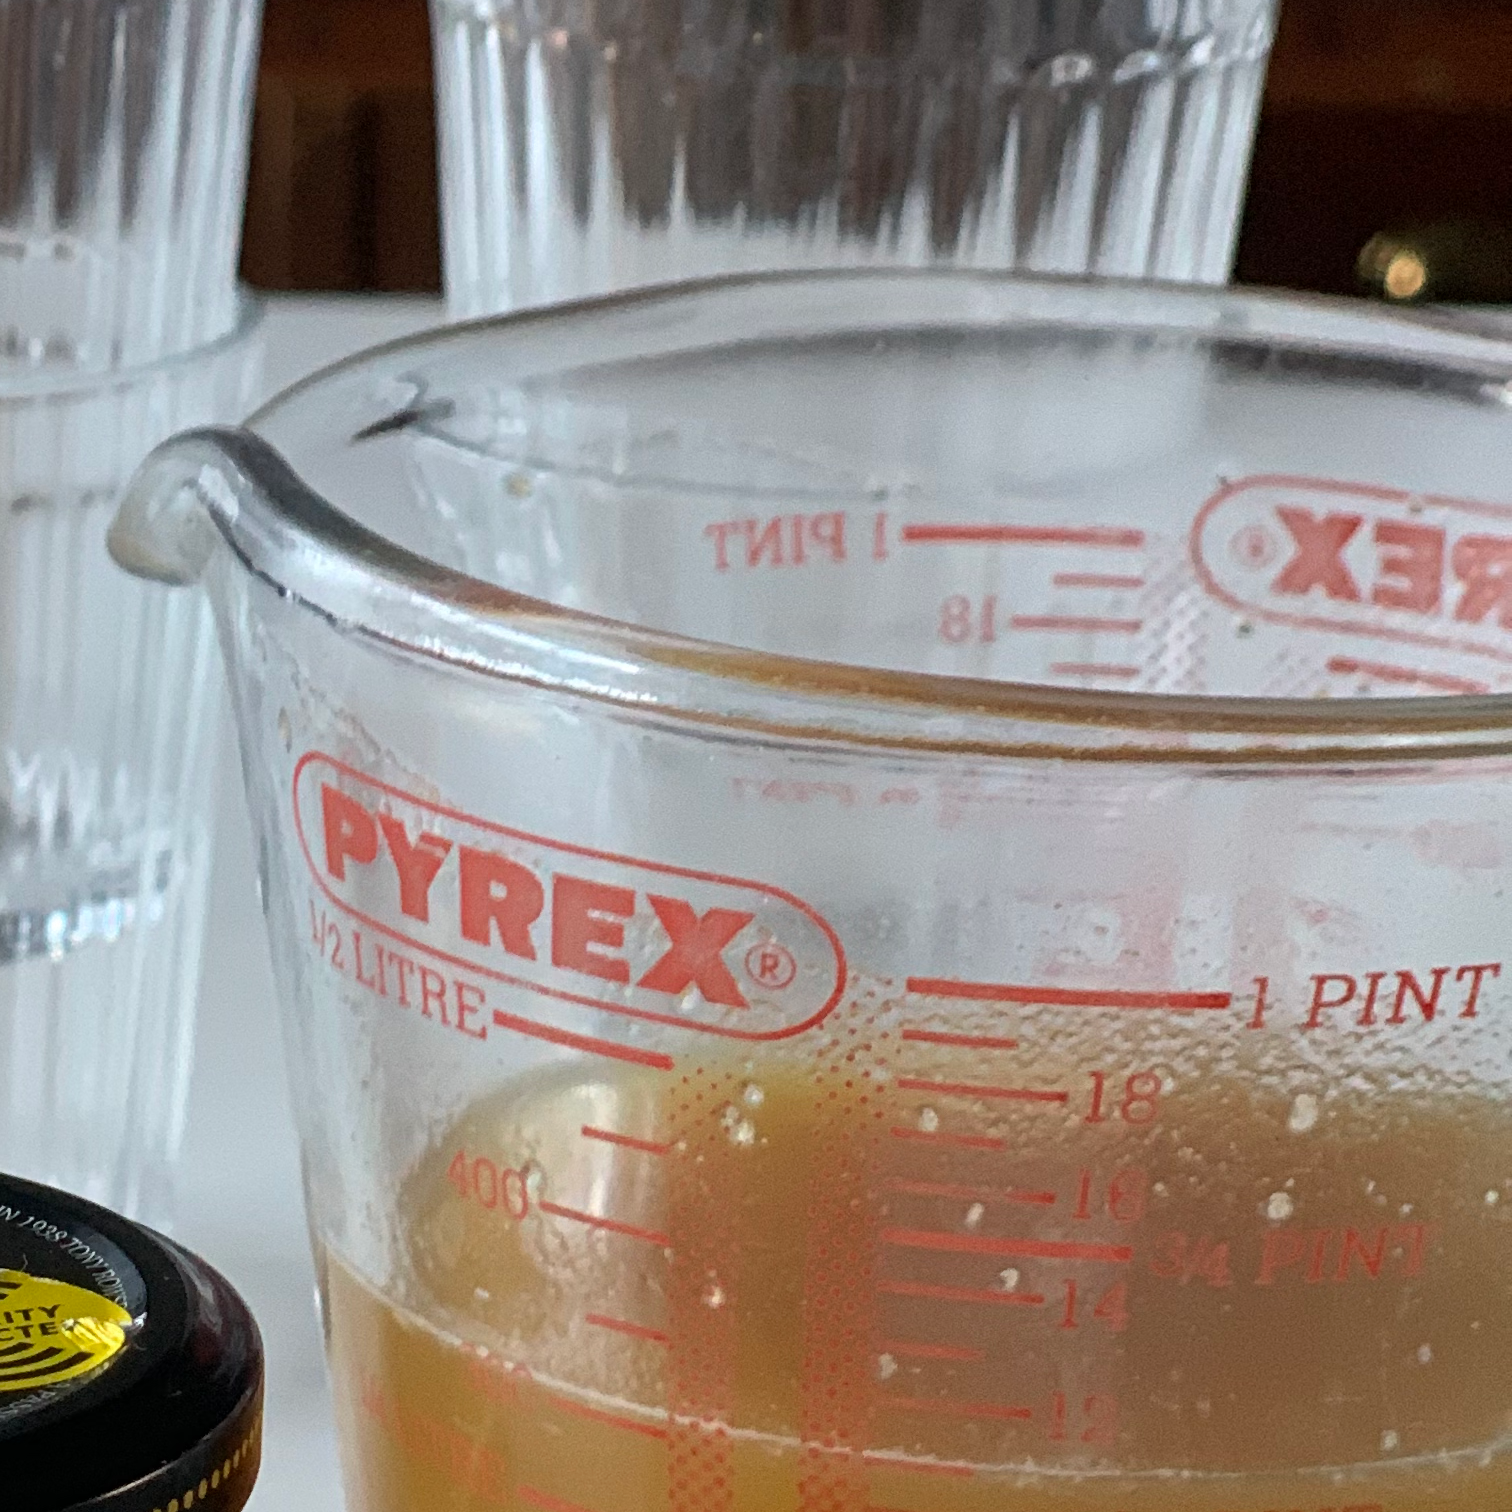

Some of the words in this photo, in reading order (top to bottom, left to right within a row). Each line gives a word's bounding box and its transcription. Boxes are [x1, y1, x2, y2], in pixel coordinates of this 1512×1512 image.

[319, 781, 755, 1010] PYREX
[352, 930, 488, 1041] LITRE
[1245, 975, 1270, 1029] 1
[1303, 962, 1502, 1030] PINT
[1082, 1070, 1162, 1125] 18
[446, 1150, 529, 1220] 400
[1072, 1168, 1148, 1223] 16
[16, 1215, 69, 1243] 1938
[1255, 1222, 1440, 1286] PINT
[1059, 1278, 1131, 1332] 14
